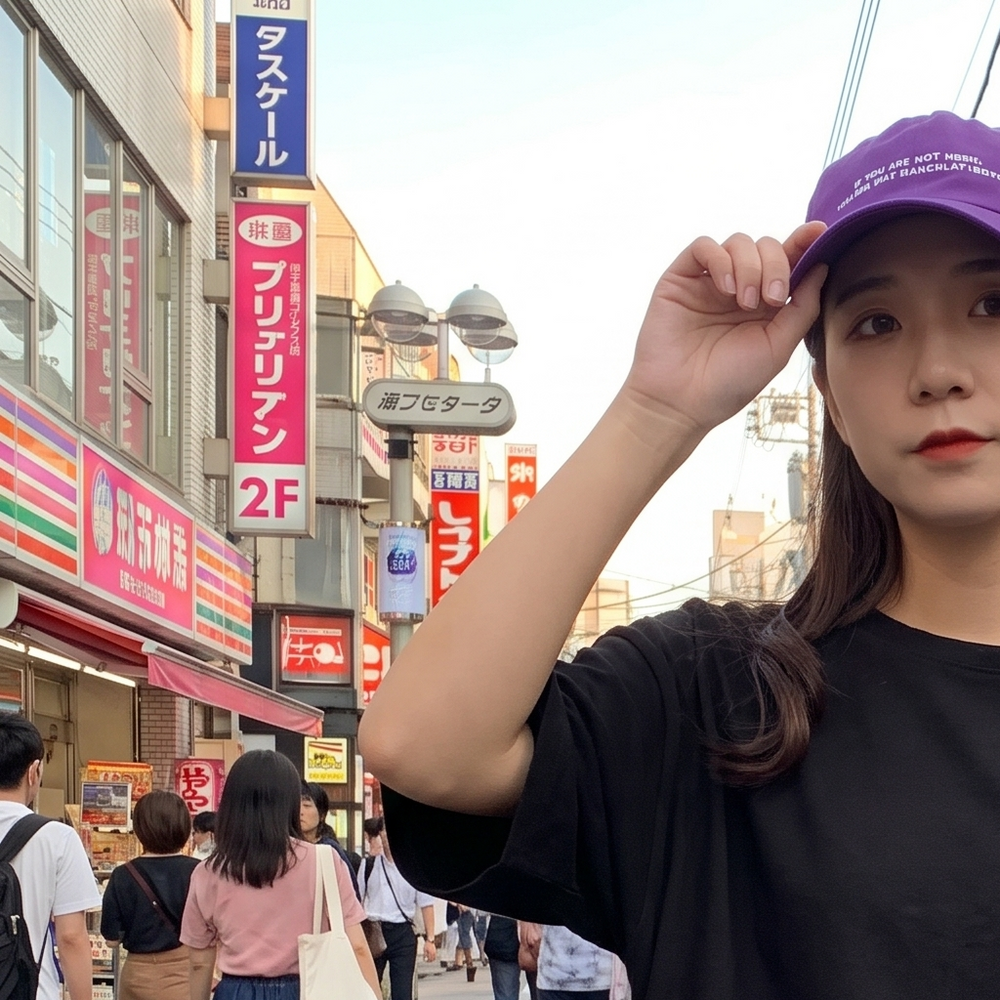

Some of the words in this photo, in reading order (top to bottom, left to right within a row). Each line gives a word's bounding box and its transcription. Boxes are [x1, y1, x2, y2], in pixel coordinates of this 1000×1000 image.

[254, 25, 289, 168] タスケール
[888, 157, 910, 171] ARE
[914, 151, 941, 165] NOT
[238, 476, 300, 519] 2F
